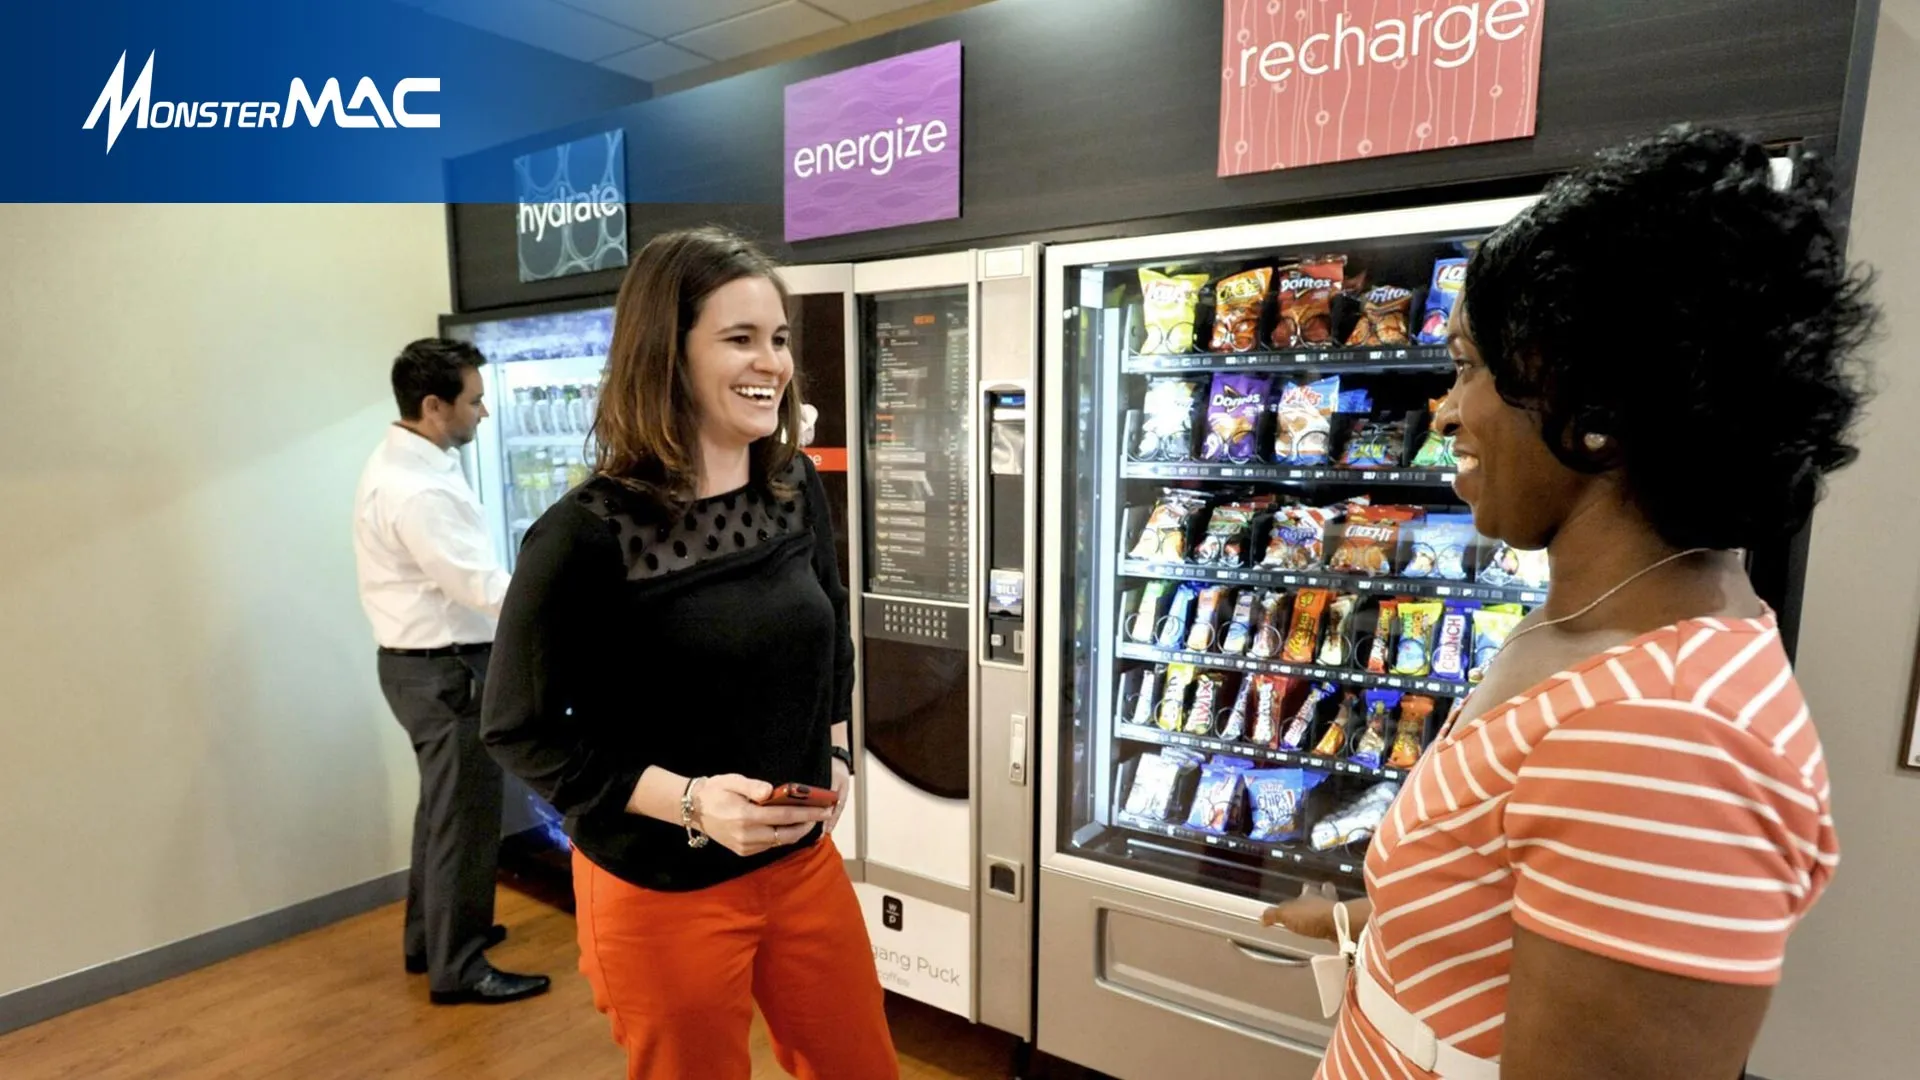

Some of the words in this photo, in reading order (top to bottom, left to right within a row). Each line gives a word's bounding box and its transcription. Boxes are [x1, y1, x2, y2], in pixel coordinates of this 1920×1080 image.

[1239, 0, 1530, 87] recharge
[793, 116, 948, 178] energize
[519, 183, 620, 242] hydrate
[1280, 277, 1332, 295] Doritos
[1366, 286, 1412, 302] Fritos
[1441, 617, 1461, 671] CRUNCH
[917, 956, 961, 987] Puck
